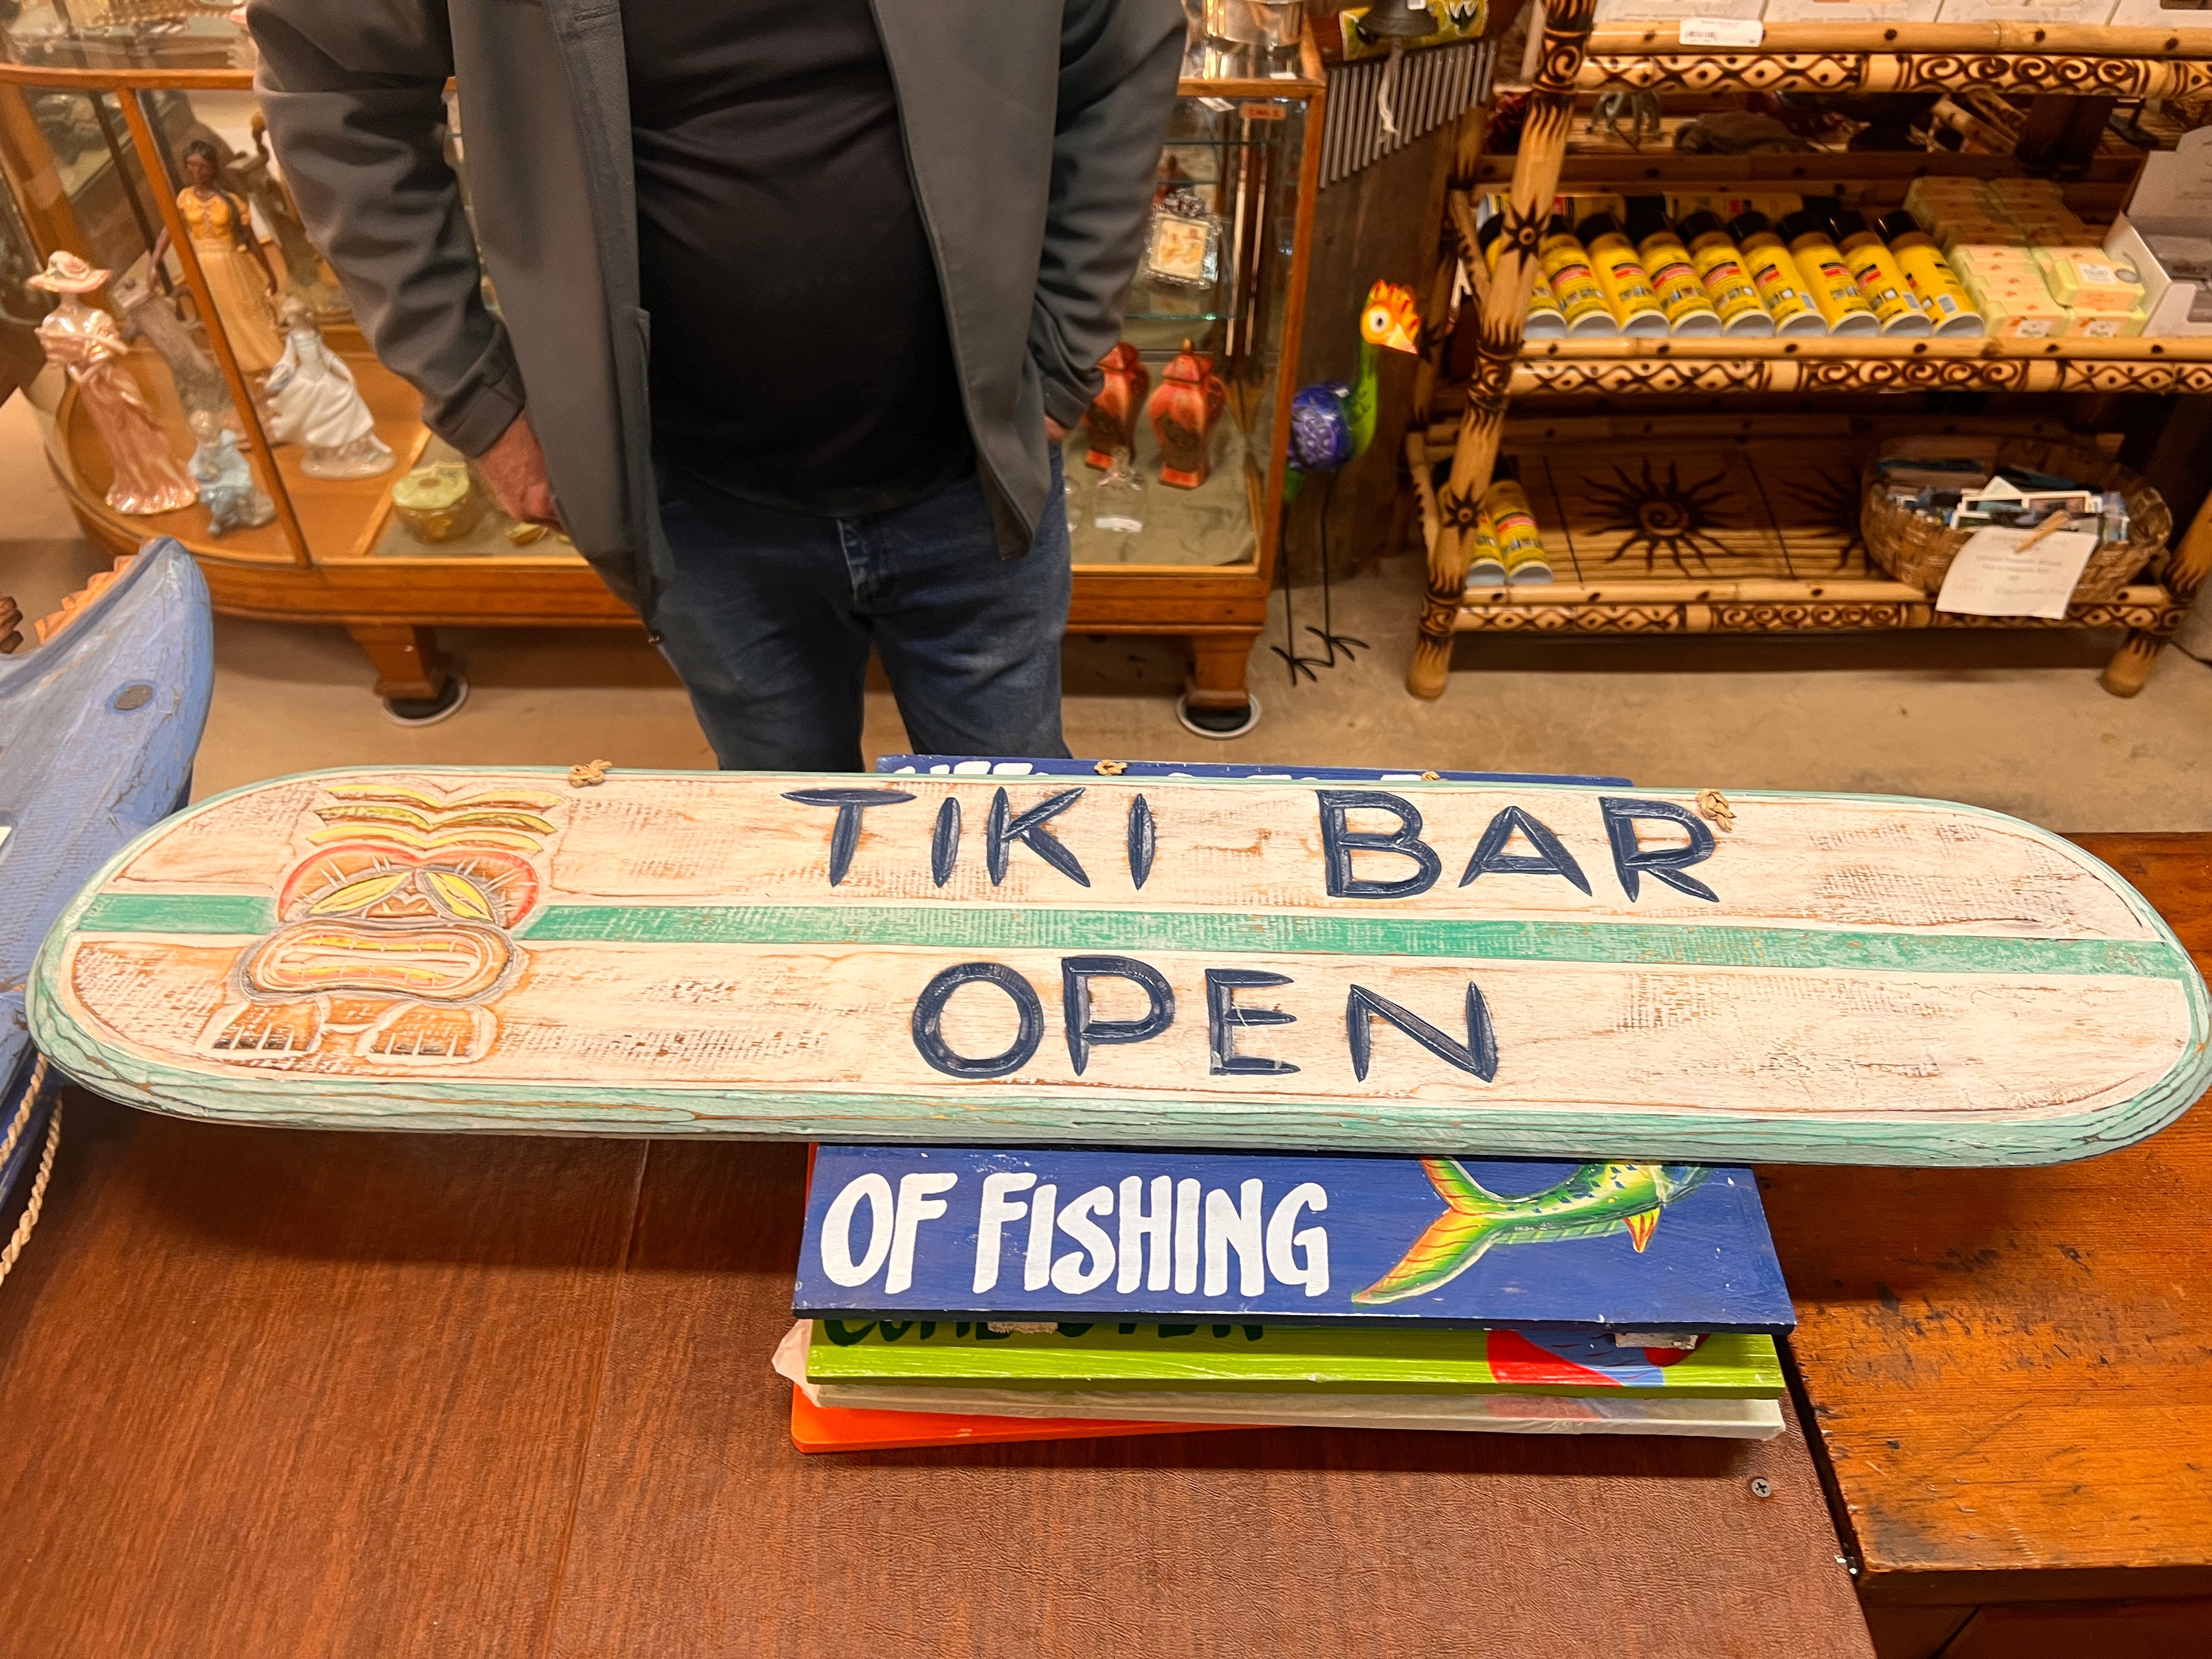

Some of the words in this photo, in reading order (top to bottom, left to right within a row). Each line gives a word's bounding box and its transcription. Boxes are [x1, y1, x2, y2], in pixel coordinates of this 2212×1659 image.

[782, 787, 1154, 890] TIKI
[1318, 790, 1720, 902] BAR
[913, 956, 1499, 1082] OPEN
[820, 1172, 958, 1293] OF
[972, 1172, 1330, 1297] FISHING
